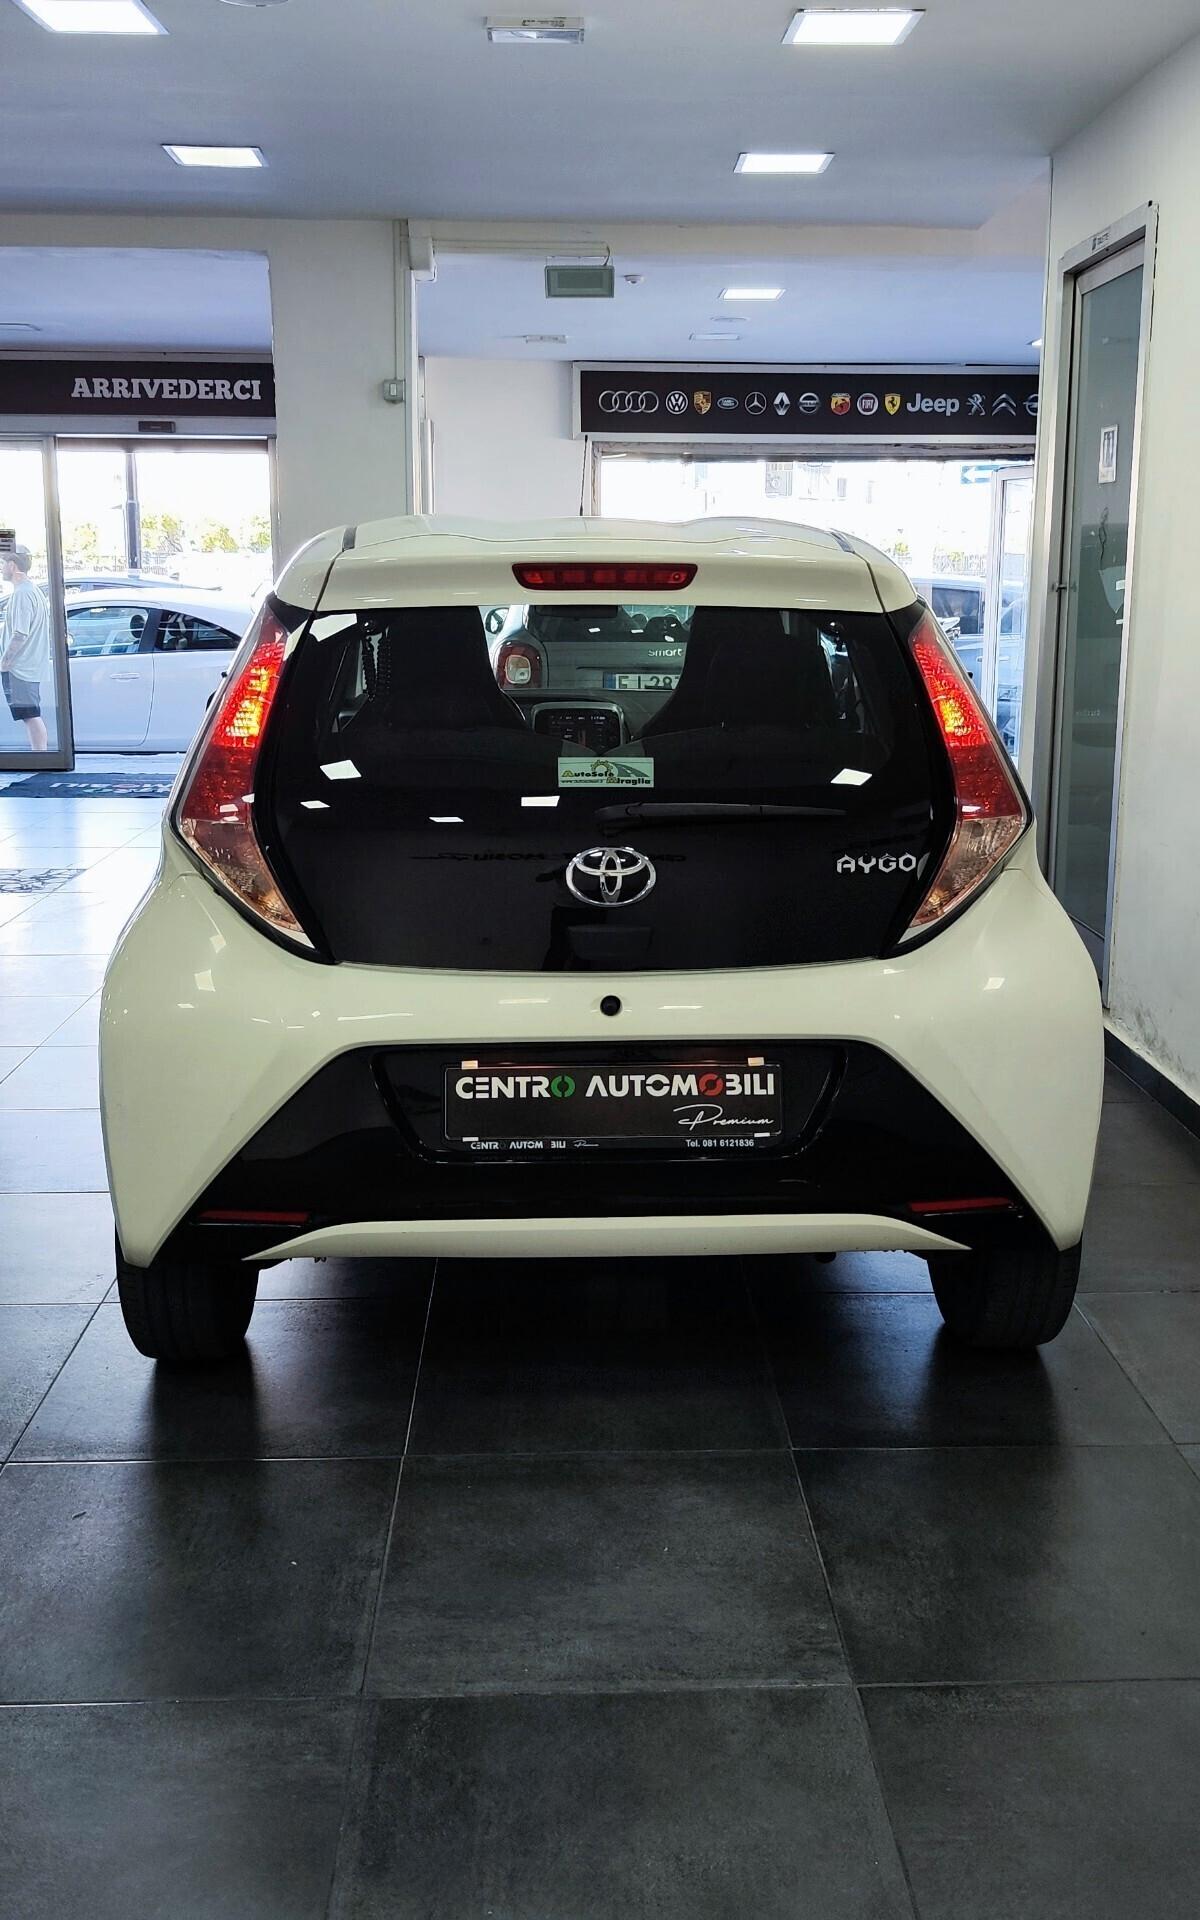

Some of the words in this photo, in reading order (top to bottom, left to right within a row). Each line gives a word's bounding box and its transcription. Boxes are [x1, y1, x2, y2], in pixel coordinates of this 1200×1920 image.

[71, 377, 261, 400] ARRIVEDERCI
[907, 393, 959, 415] Jeep
[648, 648, 683, 657] smart
[836, 852, 917, 874] AYGO
[455, 1075, 575, 1099] CENTRO
[585, 1072, 775, 1097] AUTOMOBILI
[673, 1103, 774, 1131] Premium
[686, 1140, 700, 1148] Tel.
[702, 1140, 717, 1148] 081
[719, 1139, 754, 1148] 6121836
